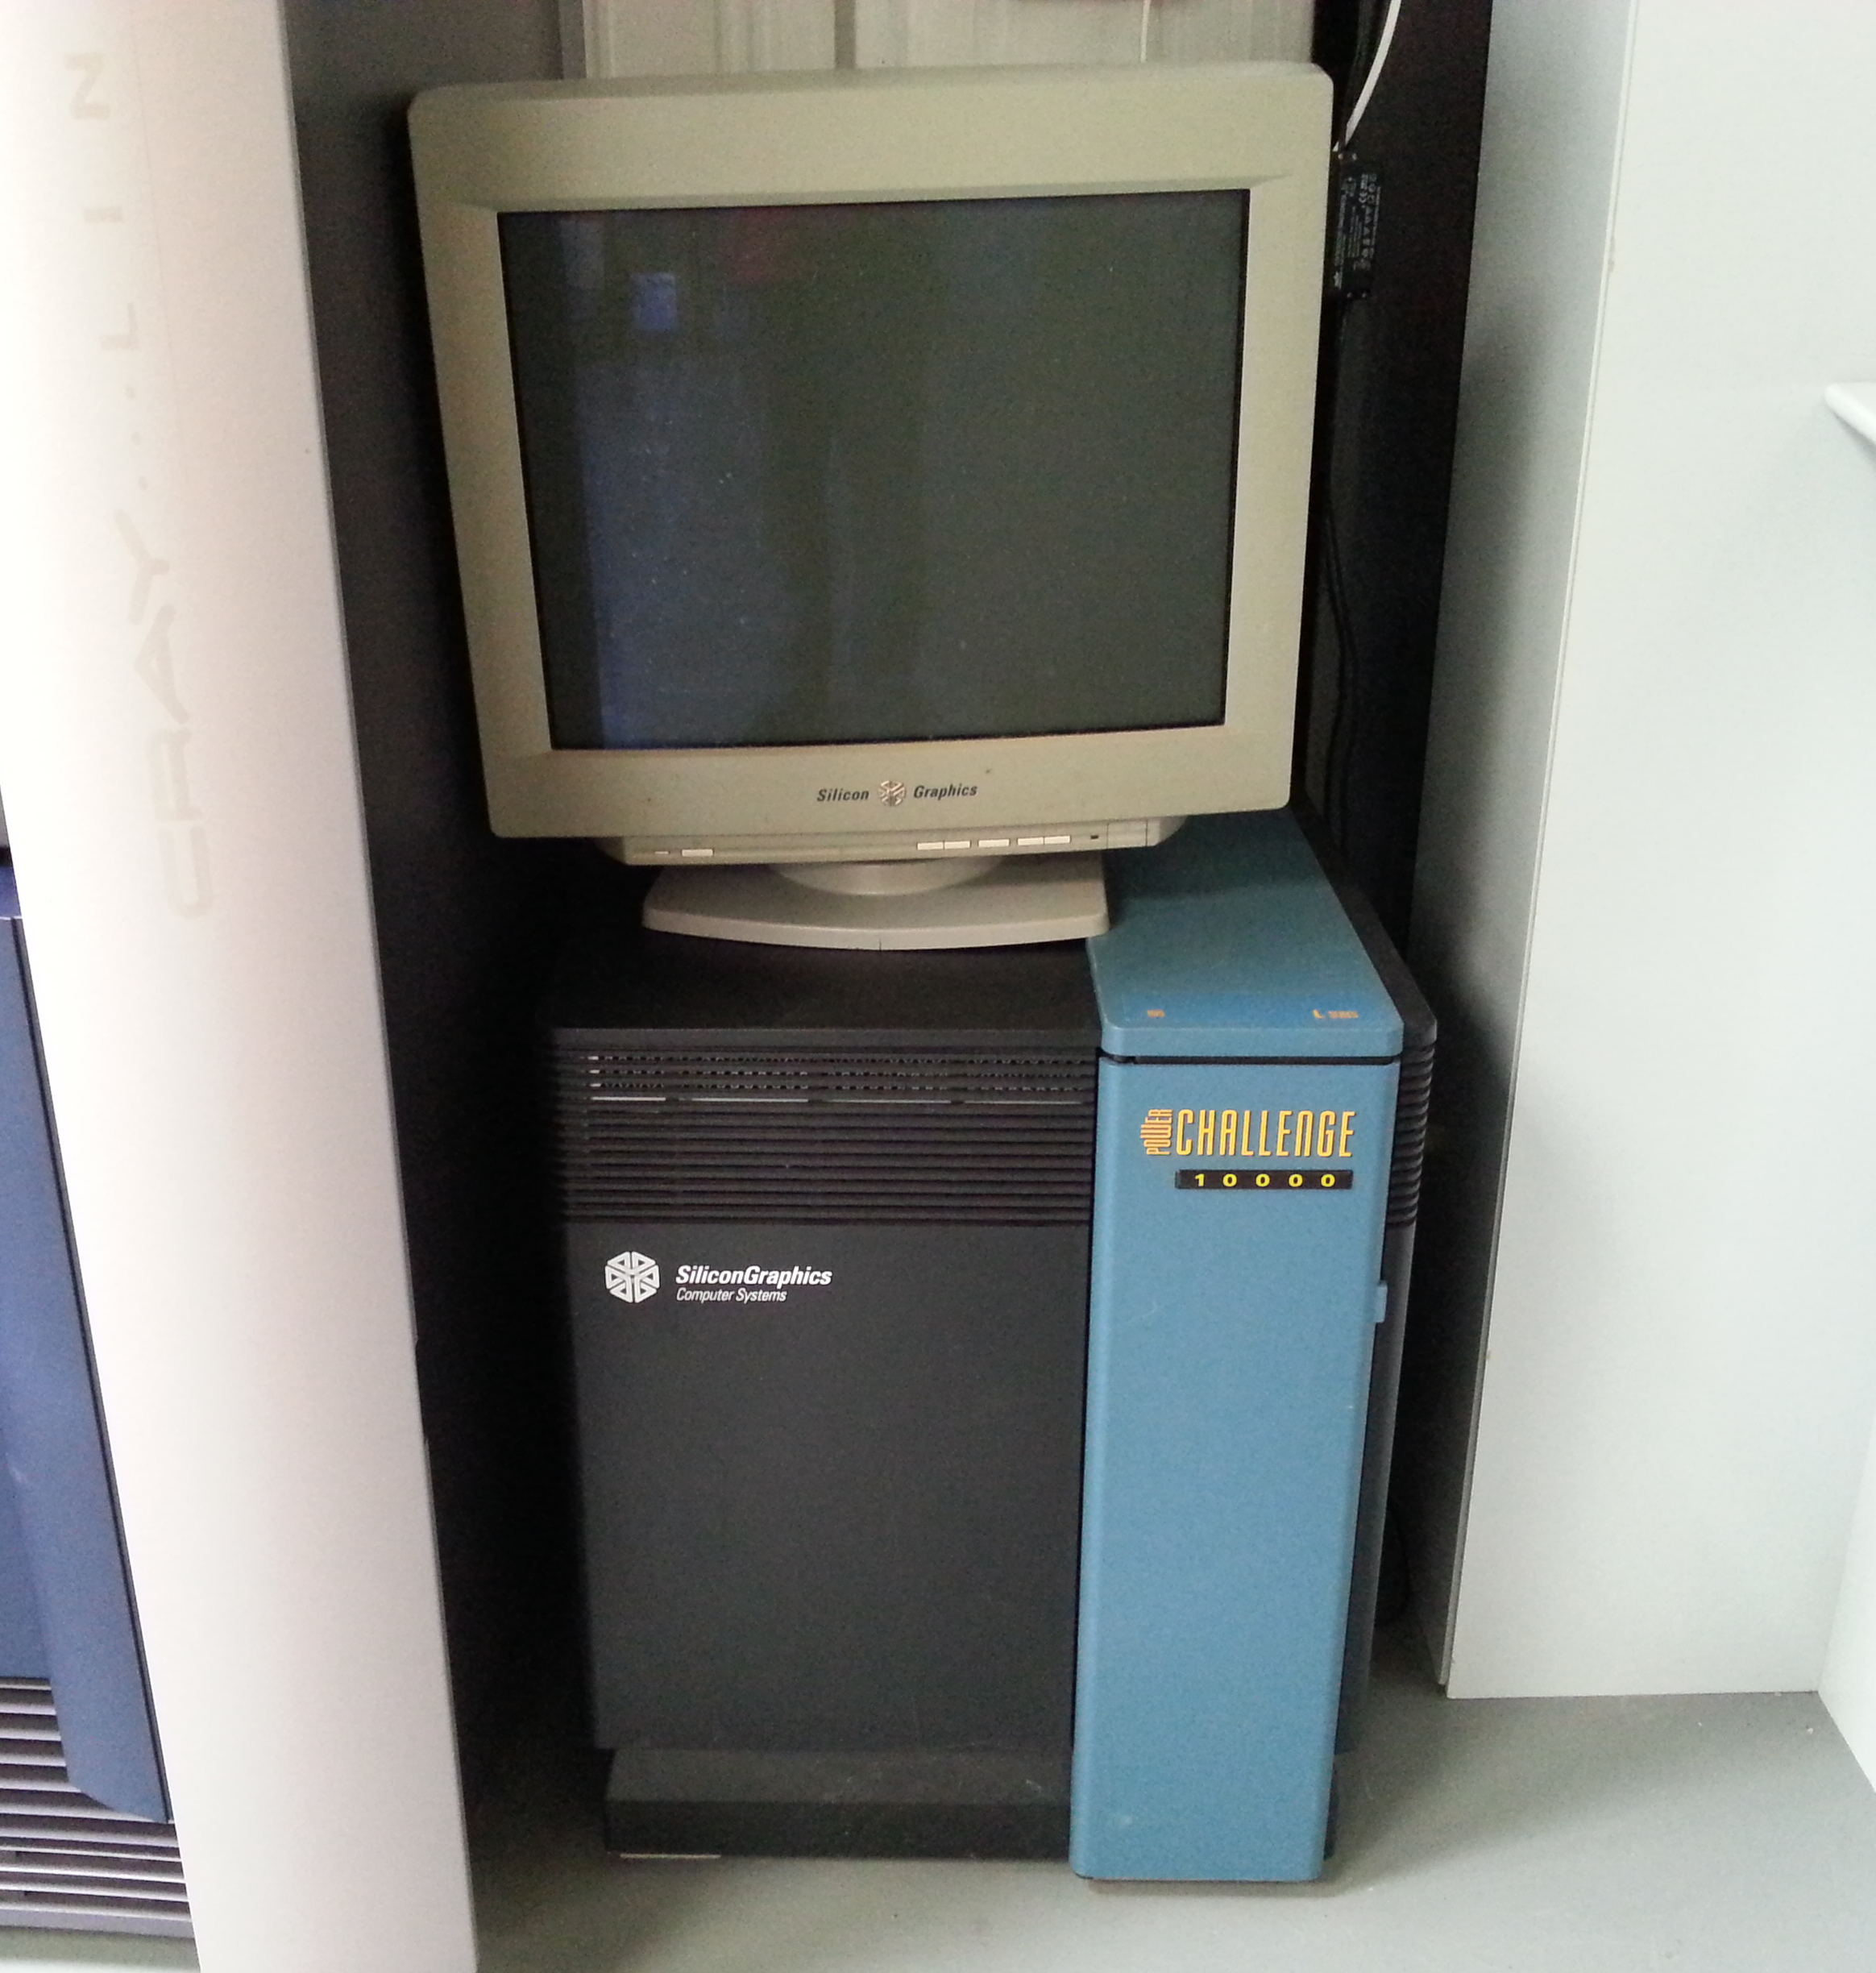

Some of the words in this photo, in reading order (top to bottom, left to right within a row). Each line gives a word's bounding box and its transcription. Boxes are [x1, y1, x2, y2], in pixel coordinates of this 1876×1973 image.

[114, 508, 215, 919] CRAY
[816, 788, 870, 802] Silicon
[913, 784, 978, 800] Graphics
[1140, 1108, 1173, 1156] POWER
[1175, 1108, 1356, 1158] CHALLENGE
[1194, 1173, 1336, 1188] 10000
[675, 1265, 833, 1290] SiliconGraphics
[676, 1286, 734, 1304] Computer
[735, 1286, 787, 1304] Systems
